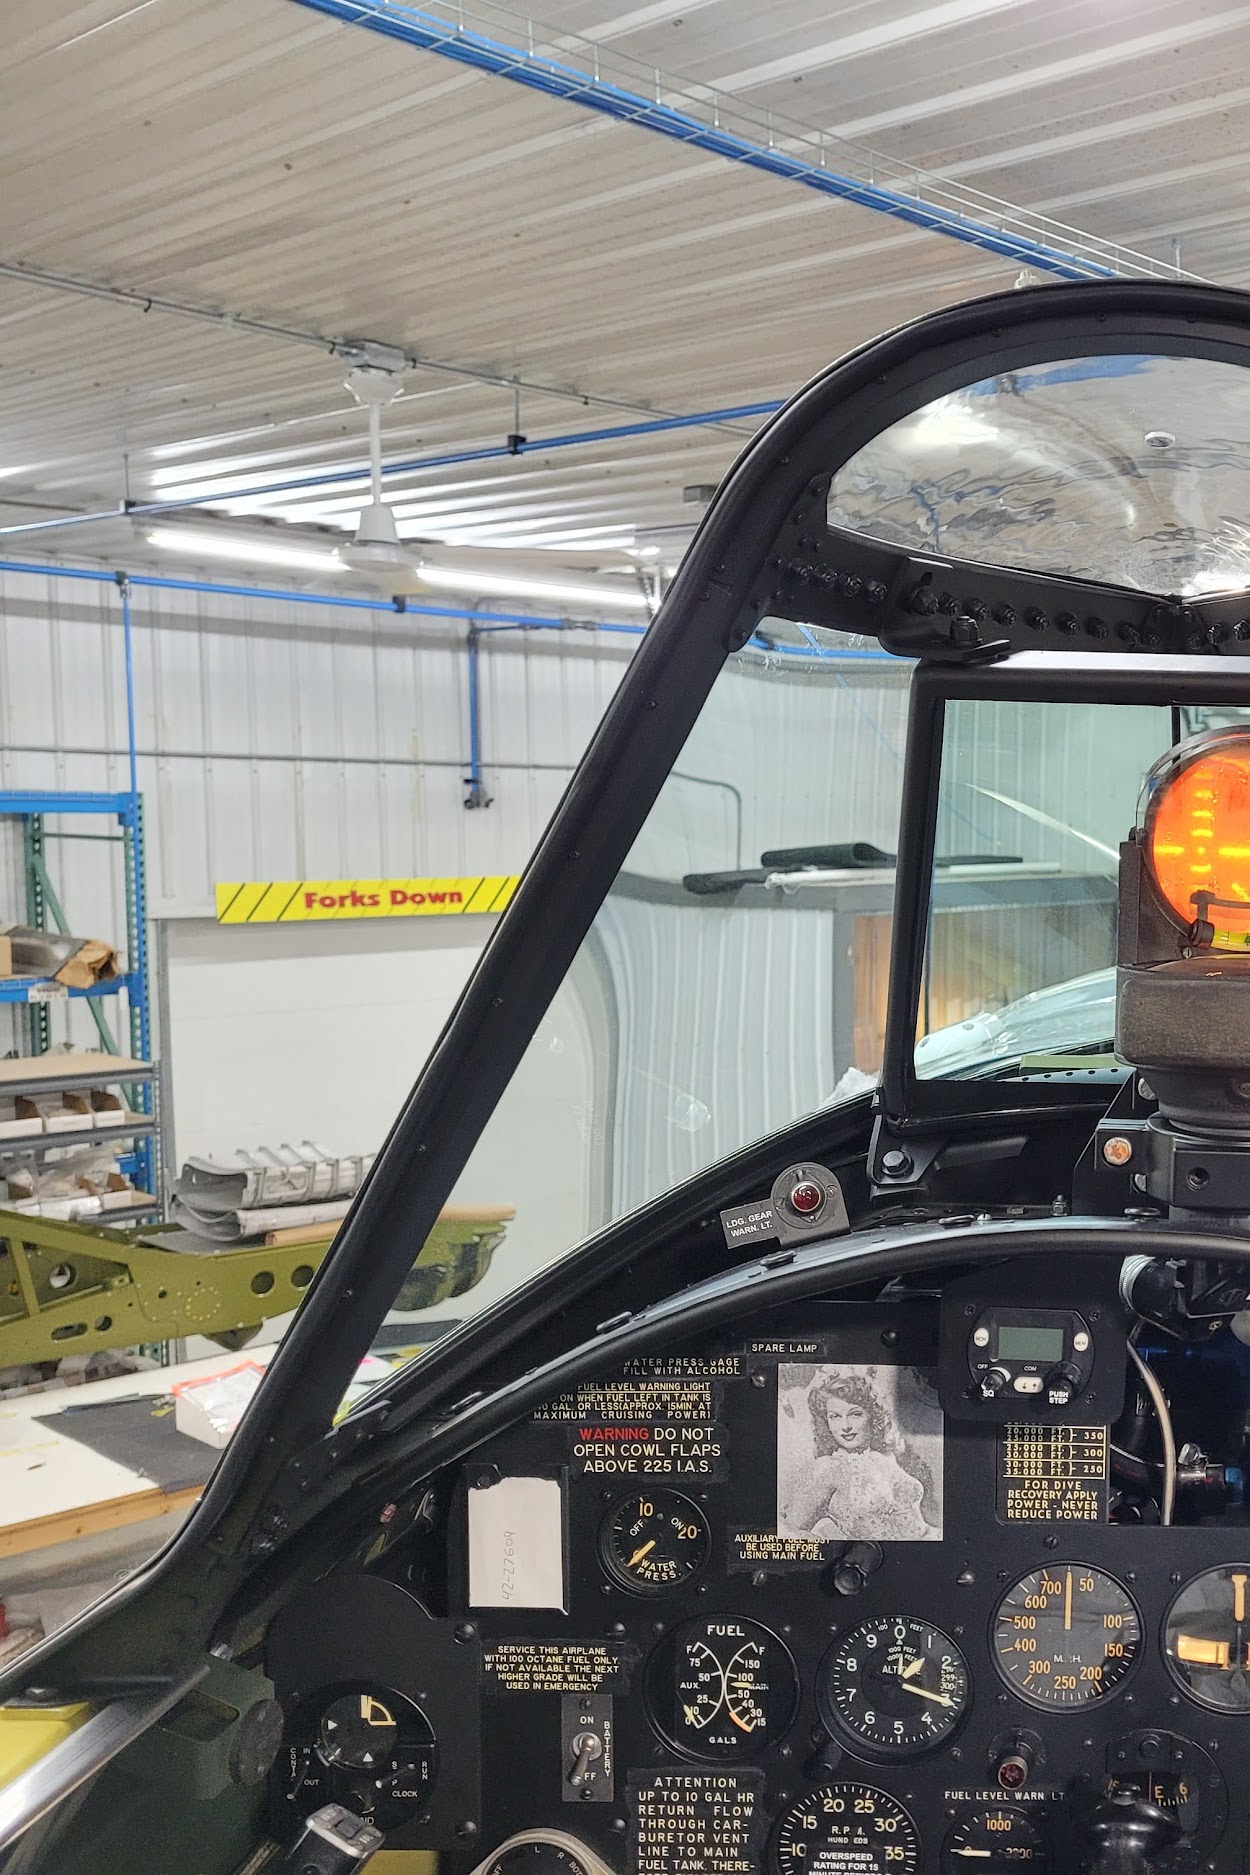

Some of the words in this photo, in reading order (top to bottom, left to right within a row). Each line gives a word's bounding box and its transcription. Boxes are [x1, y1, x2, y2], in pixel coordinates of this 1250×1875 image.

[304, 890, 380, 909] Forks
[390, 889, 463, 906] Down
[726, 1217, 747, 1229] LDG.
[748, 1210, 773, 1224] GEAR
[731, 1224, 760, 1238] WARN.
[760, 1220, 773, 1231] LT.
[752, 1343, 785, 1352] SPARE
[789, 1344, 818, 1353] LAMP
[623, 1366, 648, 1375] FILL
[654, 1367, 684, 1375] WITH
[687, 1367, 741, 1375] ALCOHOL
[560, 1394, 574, 1402] ON
[577, 1394, 603, 1402] WHEN
[606, 1394, 631, 1402] FUEL
[634, 1394, 657, 1402] LEFT
[661, 1394, 671, 1402] IN
[673, 1394, 700, 1402] TANK
[702, 1394, 711, 1402] IS
[1049, 1397, 1068, 1405] STEP
[533, 1411, 587, 1420] MAXIMUM
[601, 1411, 653, 1420] CRUISING
[667, 1411, 711, 1420] POWER)
[579, 1427, 649, 1441] WARNING
[654, 1427, 677, 1441] DO
[681, 1427, 714, 1441] NOT
[1083, 1432, 1103, 1440] 350
[573, 1444, 615, 1457] OPEN
[620, 1444, 666, 1457] COWL
[670, 1444, 721, 1457] FLAPS
[1083, 1449, 1103, 1457] 300
[583, 1460, 638, 1473] ABOVE
[643, 1460, 672, 1473] 225
[677, 1460, 712, 1473] I.A.S.
[1083, 1465, 1103, 1474] 250
[1024, 1480, 1049, 1490] FOR
[1054, 1481, 1082, 1490] DIVE
[1008, 1490, 1062, 1500] RECOVERY
[1065, 1491, 1098, 1500] APPLY
[1007, 1509, 1052, 1519] REDUCE
[1056, 1510, 1098, 1520] POWER
[734, 1534, 779, 1543] AUXILIARY
[745, 1543, 757, 1551] BE
[760, 1543, 782, 1551] USED
[784, 1544, 819, 1552] BEFORE
[740, 1551, 768, 1560] USING
[772, 1552, 796, 1560] MAIN
[800, 1552, 825, 1561] FUEL
[641, 1558, 677, 1572] WATER
[1040, 1581, 1062, 1594] 700
[1079, 1578, 1094, 1592] 50
[1024, 1595, 1047, 1609] 600
[1014, 1616, 1036, 1630] 500
[1103, 1614, 1122, 1628] 100
[707, 1625, 745, 1636] FUEL
[498, 1646, 535, 1654] SERVICE
[540, 1646, 558, 1654] THIS
[562, 1647, 606, 1655] AIRPLANE
[1014, 1638, 1037, 1652] 400
[1104, 1643, 1124, 1657] 150
[484, 1655, 506, 1663] WITH
[509, 1655, 523, 1663] 100
[527, 1655, 564, 1663] OCTANE
[567, 1656, 590, 1664] FUEL
[593, 1656, 620, 1664] ONLY.
[519, 1664, 570, 1672] AVAILABLE
[595, 1665, 619, 1673] NEXT
[1028, 1660, 1051, 1675] 300
[1079, 1666, 1102, 1681] 200
[498, 1673, 530, 1681] HIGHER
[533, 1673, 563, 1681] GRADE
[567, 1674, 587, 1682] WILL
[591, 1674, 603, 1682] BE
[1053, 1675, 1077, 1690] 250
[506, 1682, 530, 1690] USED
[533, 1682, 541, 1690] IN
[544, 1682, 598, 1691] EMERGENCY
[709, 1736, 737, 1744] GALS
[603, 1721, 611, 1777] BATTERY
[654, 1776, 737, 1788] ATTENTION
[638, 1791, 655, 1802] UP
[662, 1792, 680, 1802] TO
[686, 1792, 698, 1802] 10
[704, 1792, 731, 1803] GAL
[737, 1792, 755, 1803] HR
[638, 1805, 695, 1816] RETURN
[713, 1806, 754, 1817] FLOW
[823, 1798, 845, 1813] 20
[854, 1800, 875, 1814] 25
[639, 1818, 706, 1830] THROUGH
[713, 1819, 749, 1830] CAR-
[986, 1819, 1012, 1831] 1000
[638, 1832, 705, 1843] BURETOR
[712, 1833, 750, 1844] VENT
[638, 1846, 670, 1857] LINE
[678, 1846, 696, 1857] TO
[704, 1847, 738, 1857] MAIN
[819, 1851, 874, 1861] OVERSPEED
[638, 1860, 668, 1870] FUEL
[673, 1860, 707, 1871] TANK.
[712, 1861, 755, 1872] THERE-
[813, 1861, 847, 1870] RATING
[847, 1862, 867, 1871] FOR
[868, 1863, 879, 1871] 15
